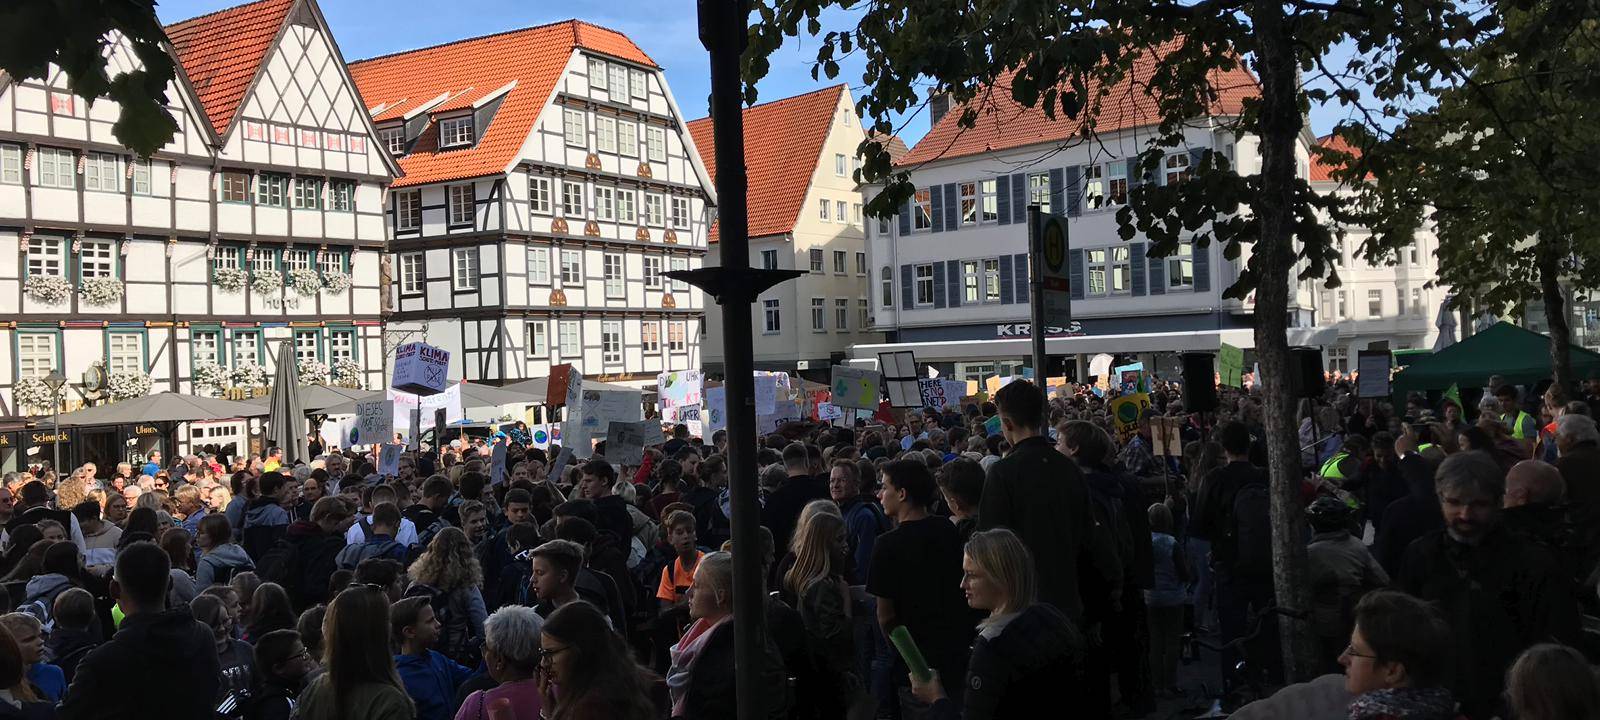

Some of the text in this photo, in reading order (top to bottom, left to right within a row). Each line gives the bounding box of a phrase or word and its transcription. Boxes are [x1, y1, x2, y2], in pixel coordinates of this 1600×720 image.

[997, 321, 1082, 336] KRSS
[396, 343, 417, 354] KLIMA
[420, 346, 448, 362] KLIMA
[920, 379, 942, 390] HERE
[930, 387, 945, 397] NO
[356, 401, 384, 416] DIESES
